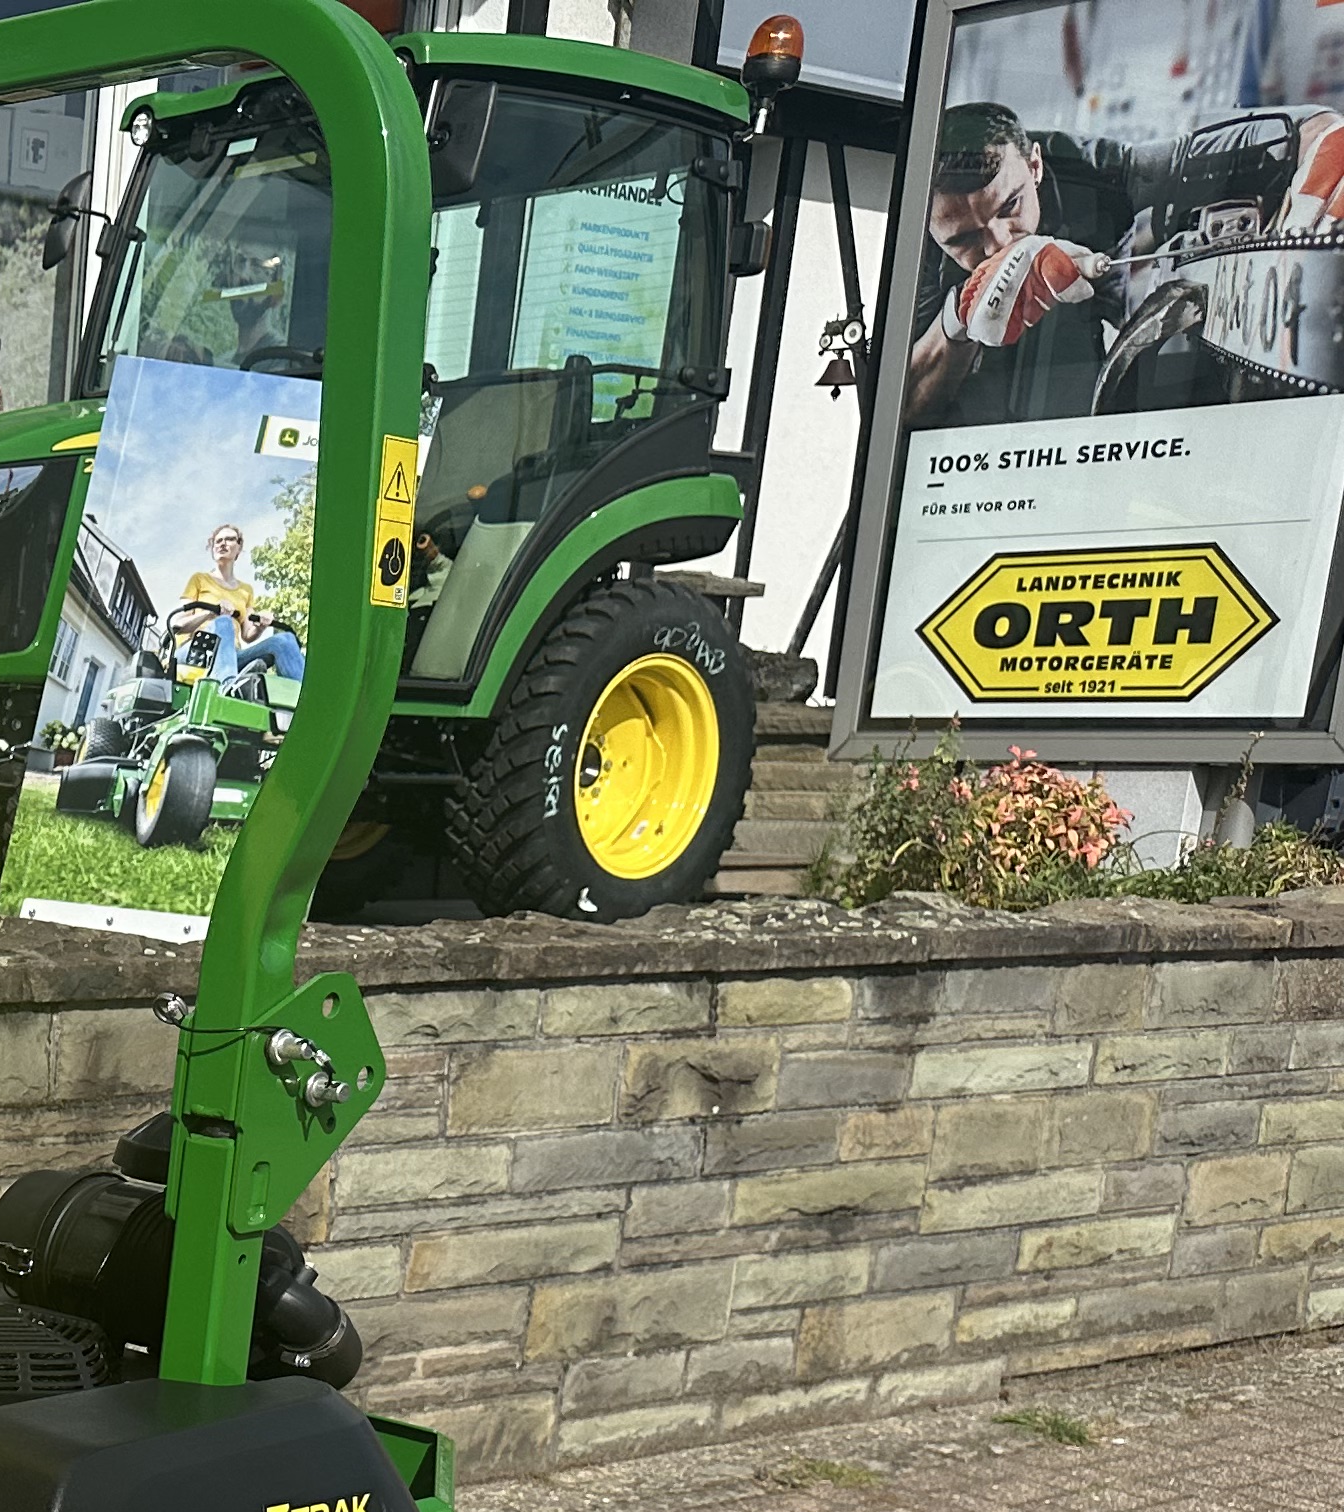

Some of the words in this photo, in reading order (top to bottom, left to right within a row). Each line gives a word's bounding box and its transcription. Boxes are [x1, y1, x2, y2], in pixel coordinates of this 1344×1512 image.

[987, 251, 1025, 309] STIHL
[928, 453, 991, 475] 100%
[997, 446, 1068, 470] STIHL
[1075, 437, 1192, 464] SERVICE.
[921, 502, 947, 516] FÜR
[950, 502, 971, 515] SIE
[976, 500, 1003, 513] VOR
[1006, 498, 1037, 512] ORT.
[1016, 570, 1183, 593] LANDTECHNIK
[973, 596, 1219, 650] ORTH
[999, 650, 1173, 672] MOTORGERÄTE
[1044, 680, 1073, 693] seit
[1078, 679, 1116, 693] 1921
